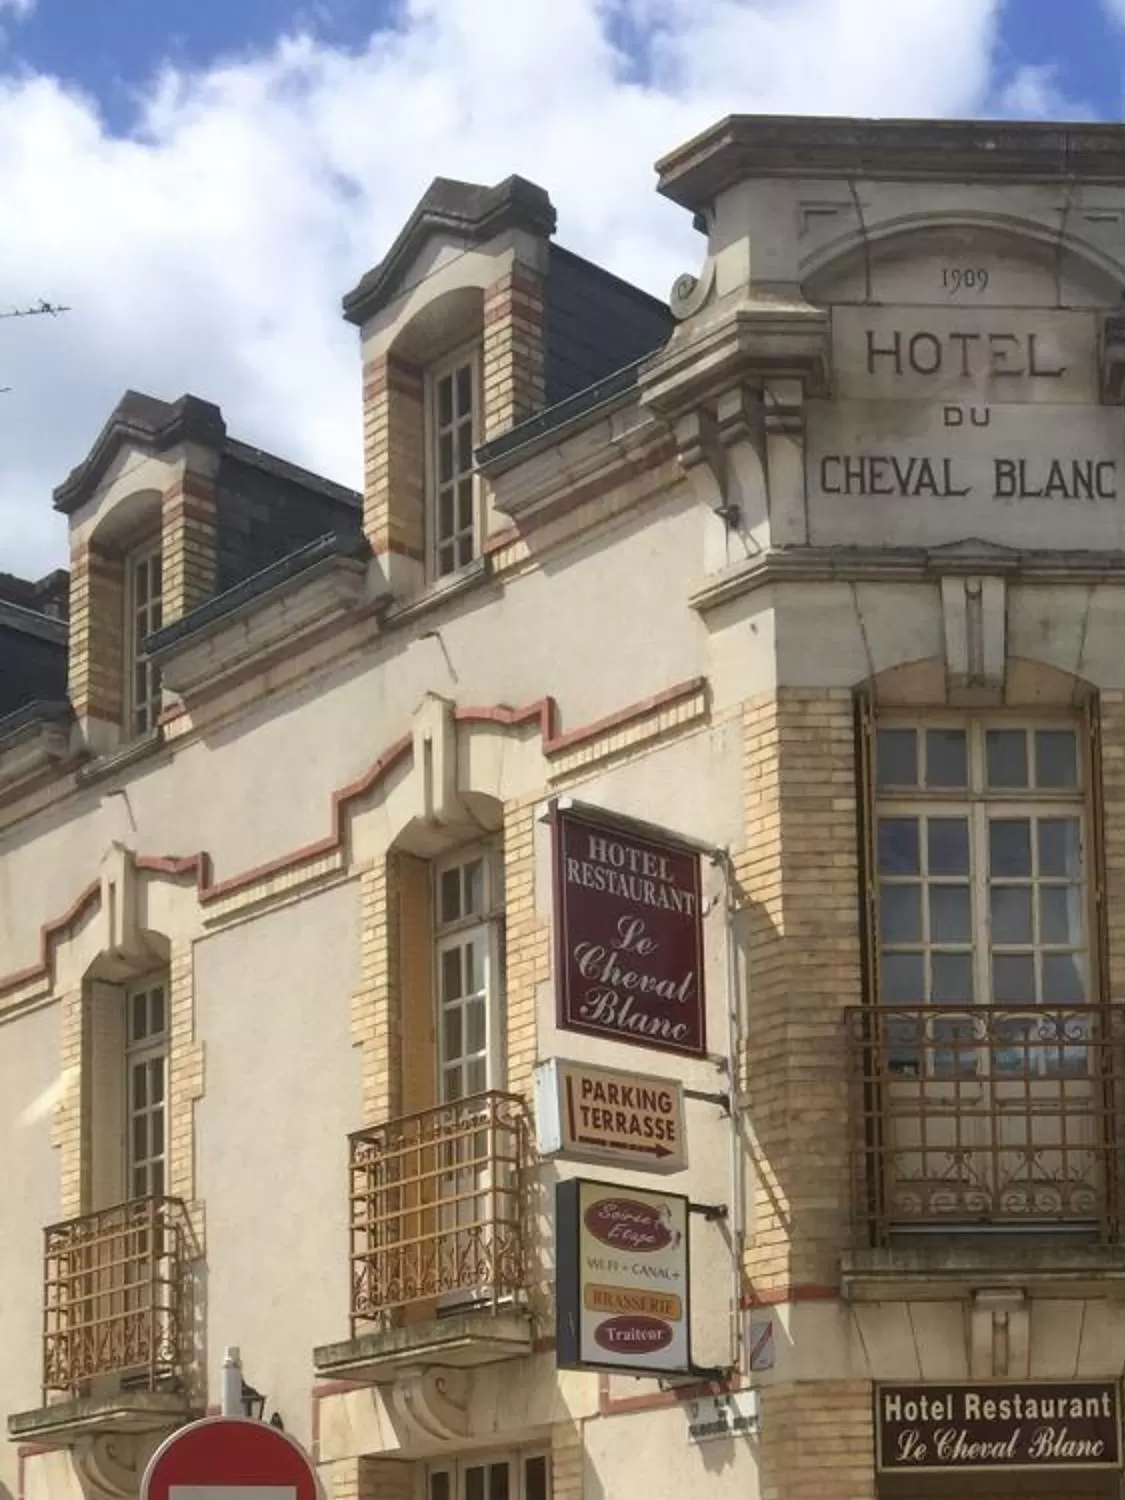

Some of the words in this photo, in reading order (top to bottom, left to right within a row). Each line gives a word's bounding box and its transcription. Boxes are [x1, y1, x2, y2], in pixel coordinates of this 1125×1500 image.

[866, 330, 1067, 378] HOTEL
[943, 406, 991, 427] DU
[820, 455, 972, 497] CHEVAL
[994, 458, 1117, 499] BLANC
[588, 834, 675, 882] HOTEL
[567, 858, 695, 916] RESTAURANT
[612, 915, 658, 957] Le
[573, 941, 693, 1003] Cheval
[579, 986, 689, 1041] Blanc
[581, 1078, 673, 1114] PARKING
[579, 1104, 676, 1141] TERRASSE
[593, 1290, 674, 1314] BRASSERIE
[606, 1327, 665, 1342] Traiteur
[884, 1394, 953, 1422] Hotel
[965, 1391, 1111, 1421] Restaurant
[895, 1429, 928, 1462] Le
[932, 1427, 1018, 1461] Cheval
[1027, 1427, 1105, 1459] Blanc
